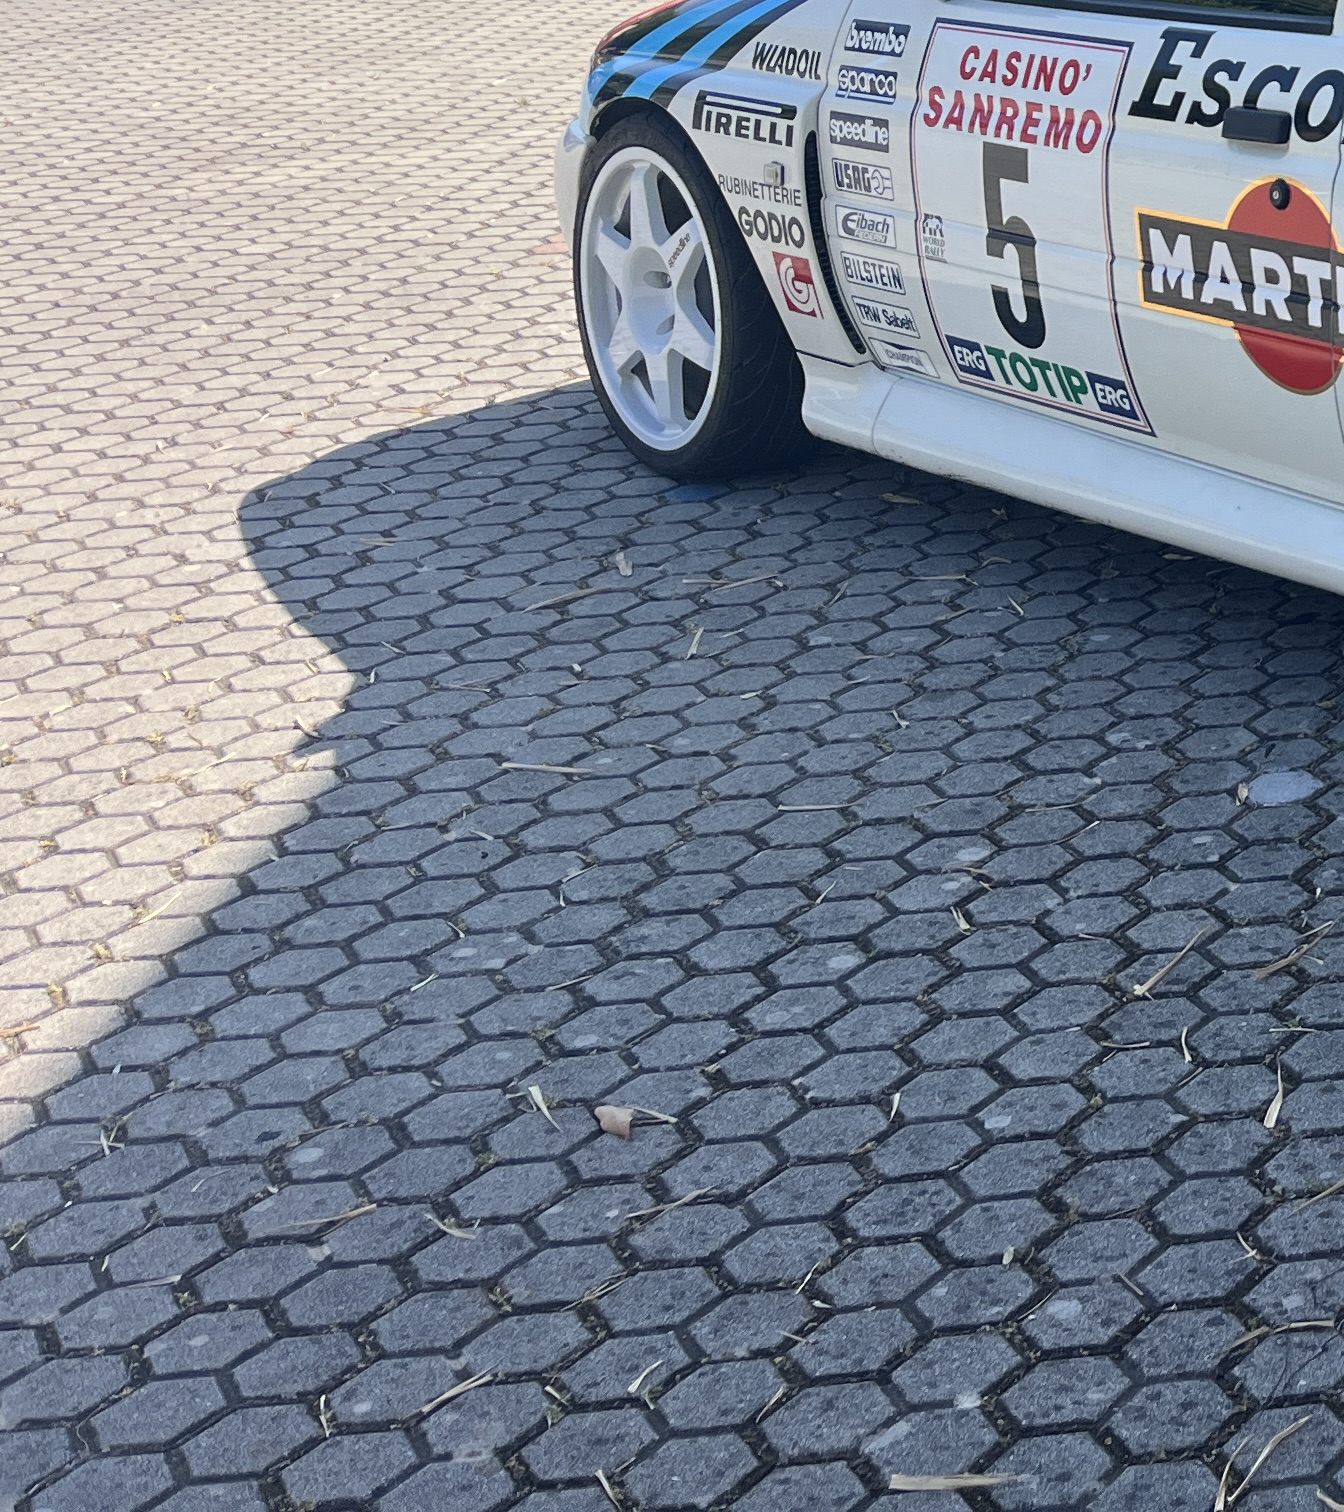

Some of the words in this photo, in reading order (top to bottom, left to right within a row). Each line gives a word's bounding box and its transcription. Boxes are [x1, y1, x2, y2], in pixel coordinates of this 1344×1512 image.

[845, 21, 906, 54] brembo
[839, 69, 896, 98] sparco
[692, 89, 798, 147] PIRELLI
[830, 118, 888, 145] speedline
[923, 85, 1102, 154] SANREMO
[718, 173, 802, 207] RUBINETTERIE
[834, 161, 871, 193] USAG
[738, 206, 805, 249] GODIO
[842, 212, 889, 237] Eibach
[982, 142, 1047, 349] 5
[843, 256, 903, 290] BILSTEIN
[856, 302, 881, 323] TRW
[953, 344, 986, 371] ERG
[984, 345, 1089, 406] TOTIP
[1094, 382, 1131, 411] ERG
